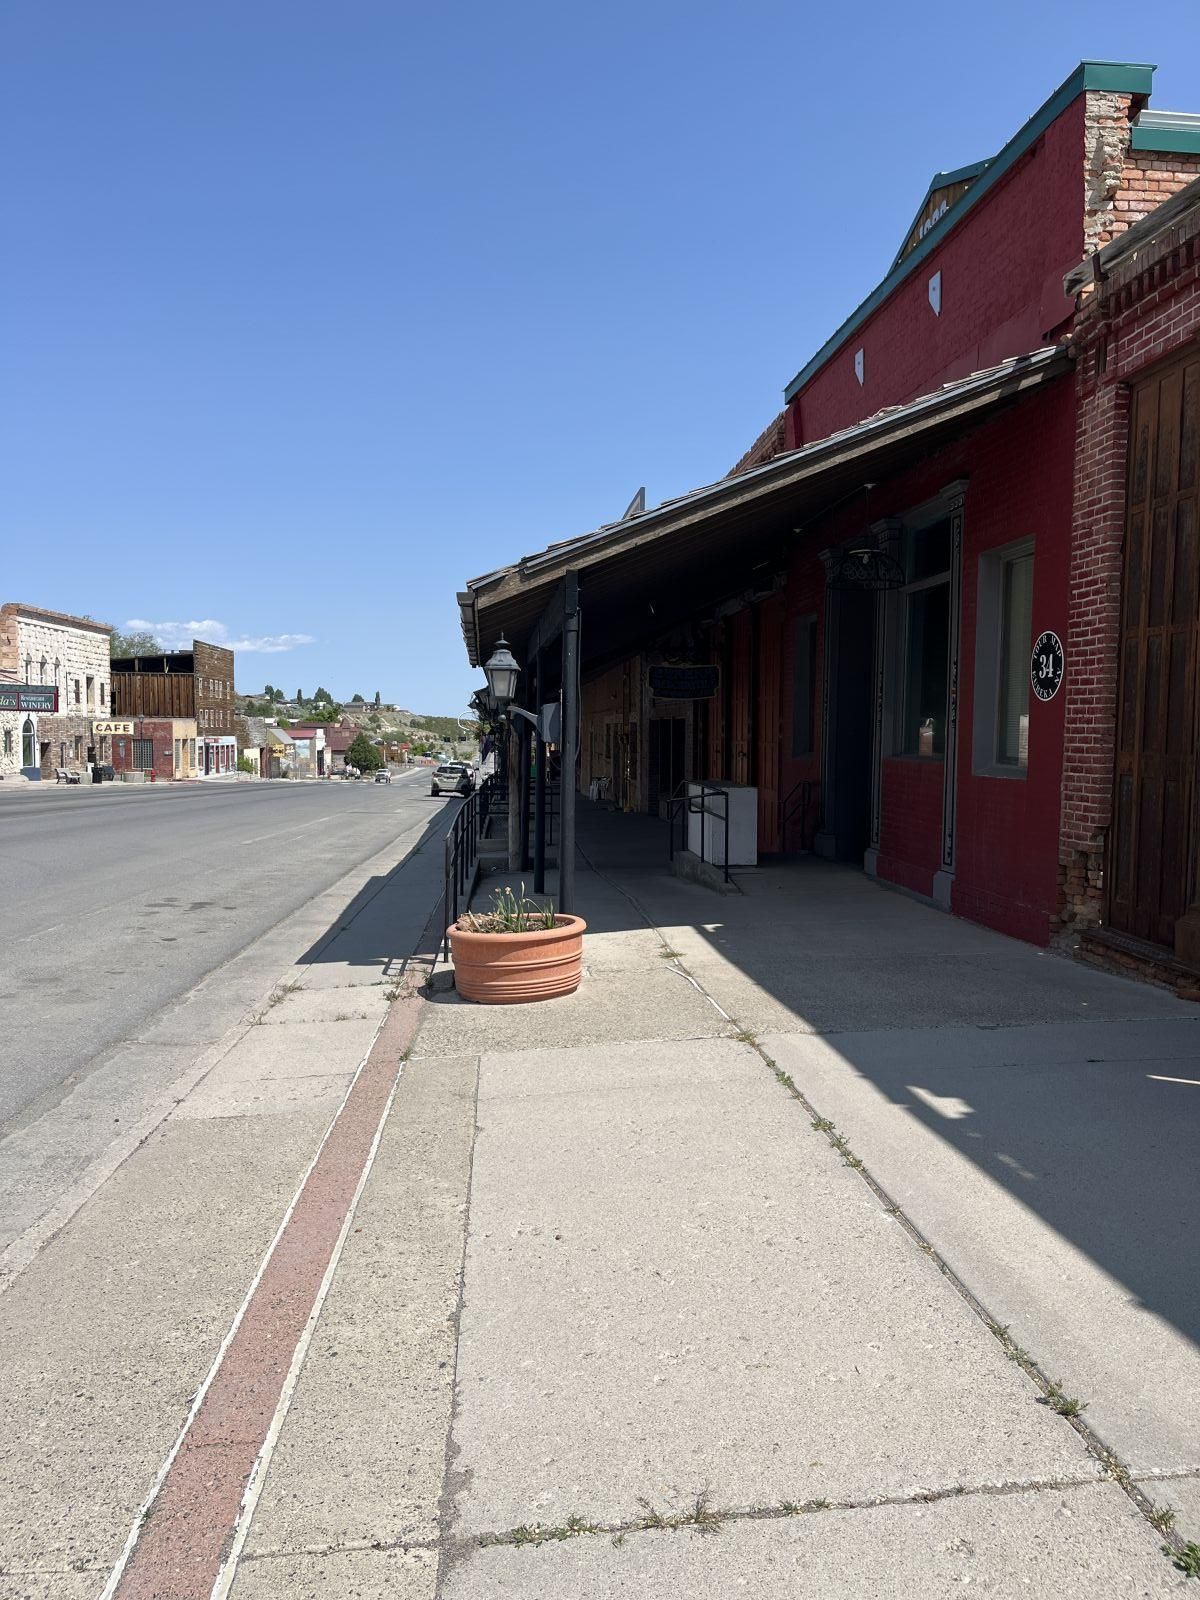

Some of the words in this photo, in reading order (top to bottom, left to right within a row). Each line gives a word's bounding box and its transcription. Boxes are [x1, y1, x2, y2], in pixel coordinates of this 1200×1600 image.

[1039, 653, 1054, 679] 34
[20, 701, 52, 709] WINERY
[95, 723, 131, 732] CAFE
